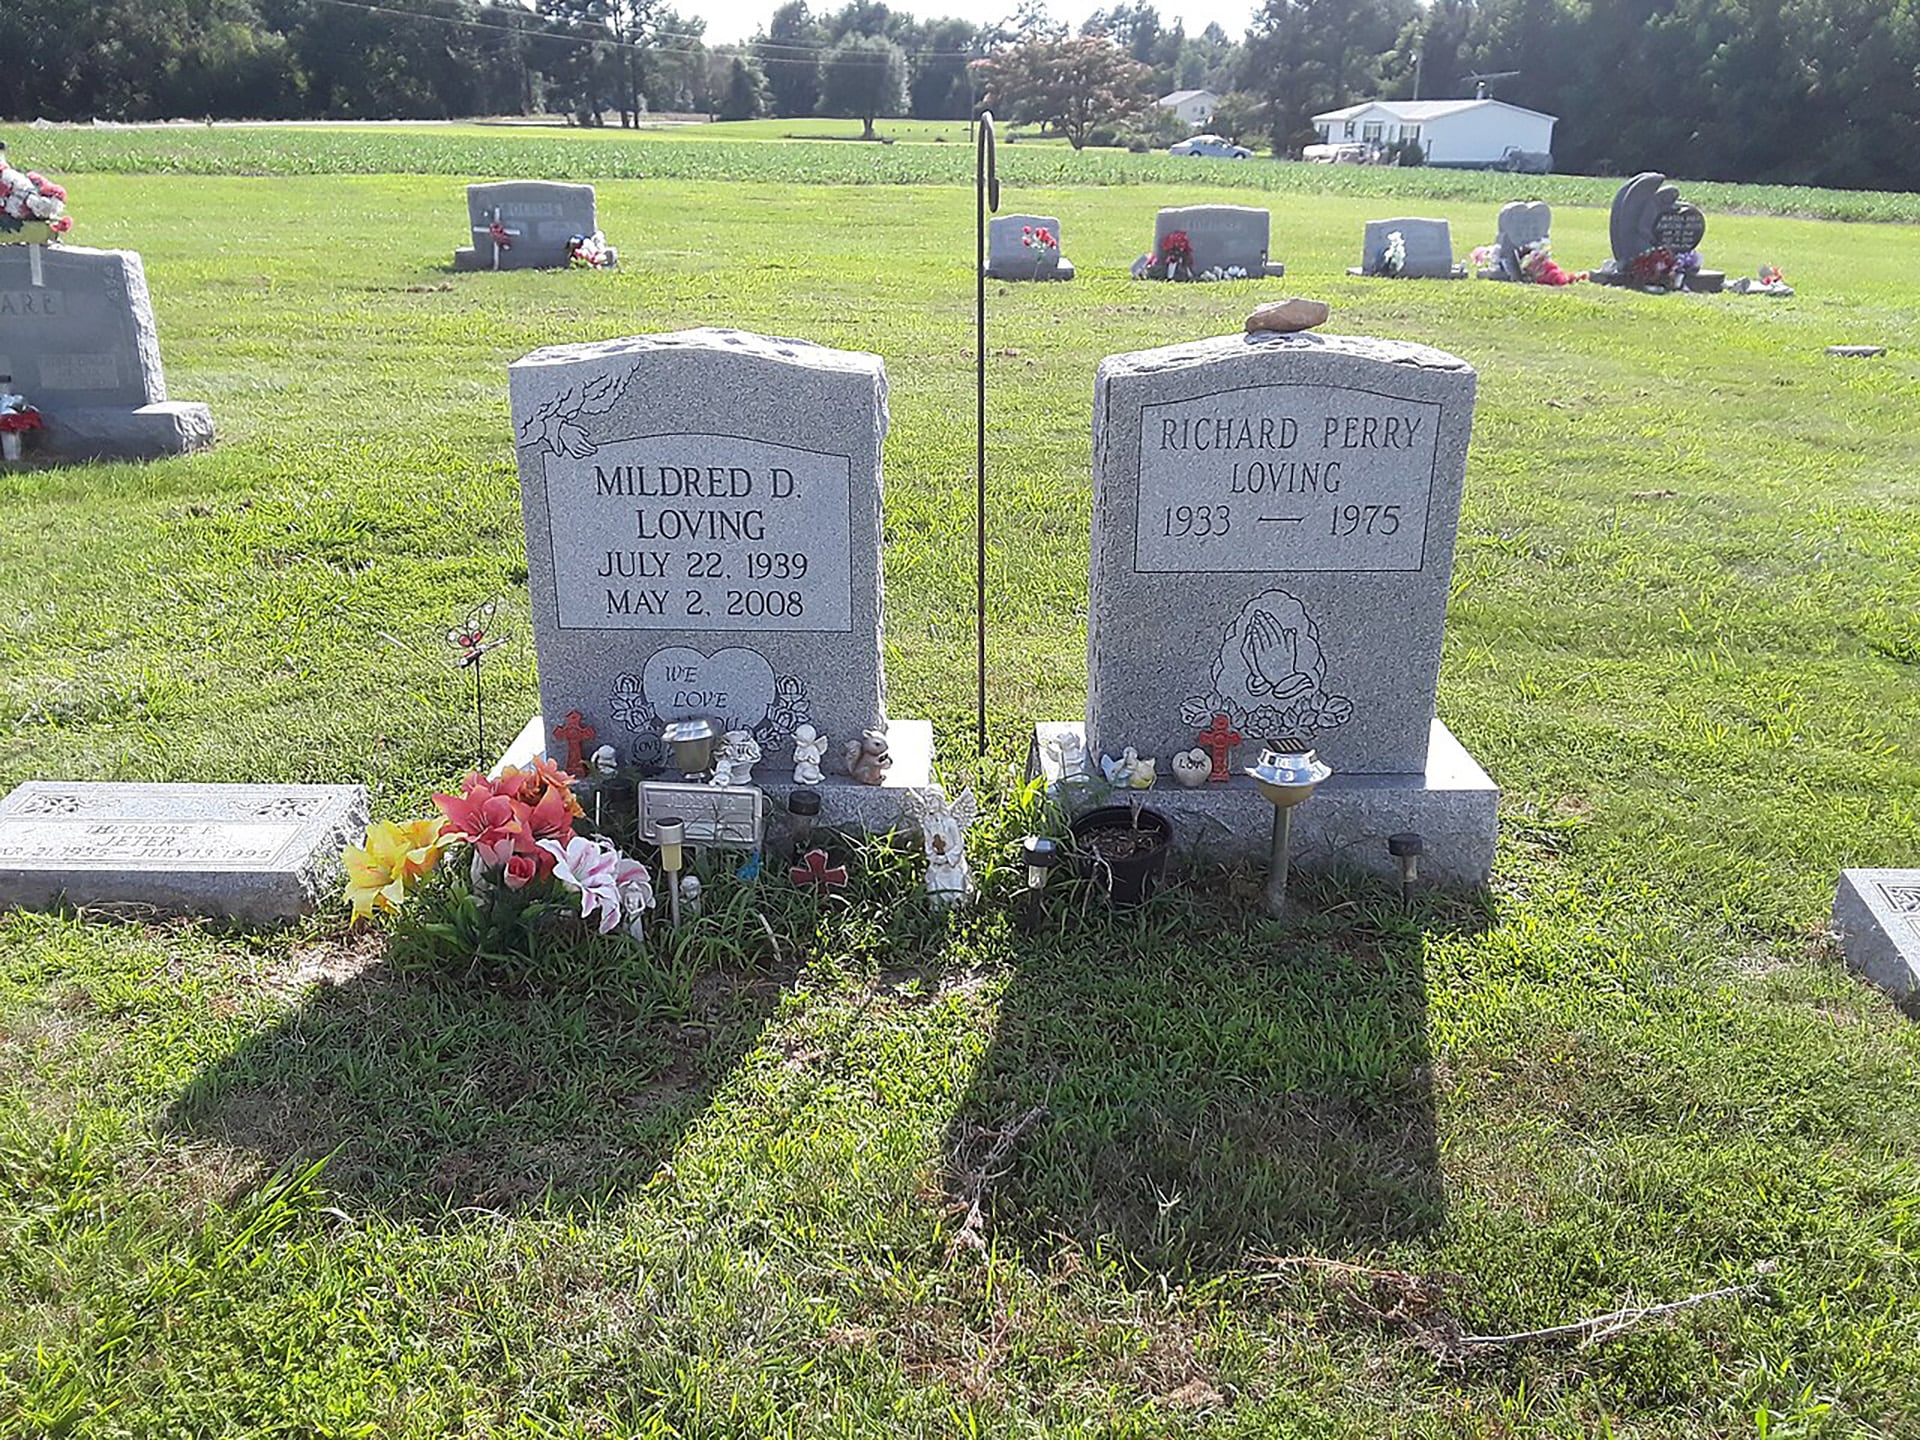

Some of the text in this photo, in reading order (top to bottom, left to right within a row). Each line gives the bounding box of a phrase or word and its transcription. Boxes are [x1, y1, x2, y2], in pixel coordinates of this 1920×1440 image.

[1160, 416, 1424, 450] RICHARD PERRY
[594, 465, 802, 499] MILDRED D.
[1230, 461, 1342, 494] LOVING
[636, 509, 766, 541] LOVING
[1163, 505, 1232, 537] 1933
[1330, 503, 1401, 536] 1975
[598, 552, 671, 579] JULY
[748, 552, 808, 580] 1939
[606, 589, 670, 615] MAY
[727, 590, 804, 617] 2008
[665, 665, 698, 683] WE
[673, 690, 729, 709] LOVE
[97, 836, 176, 847] JETER
